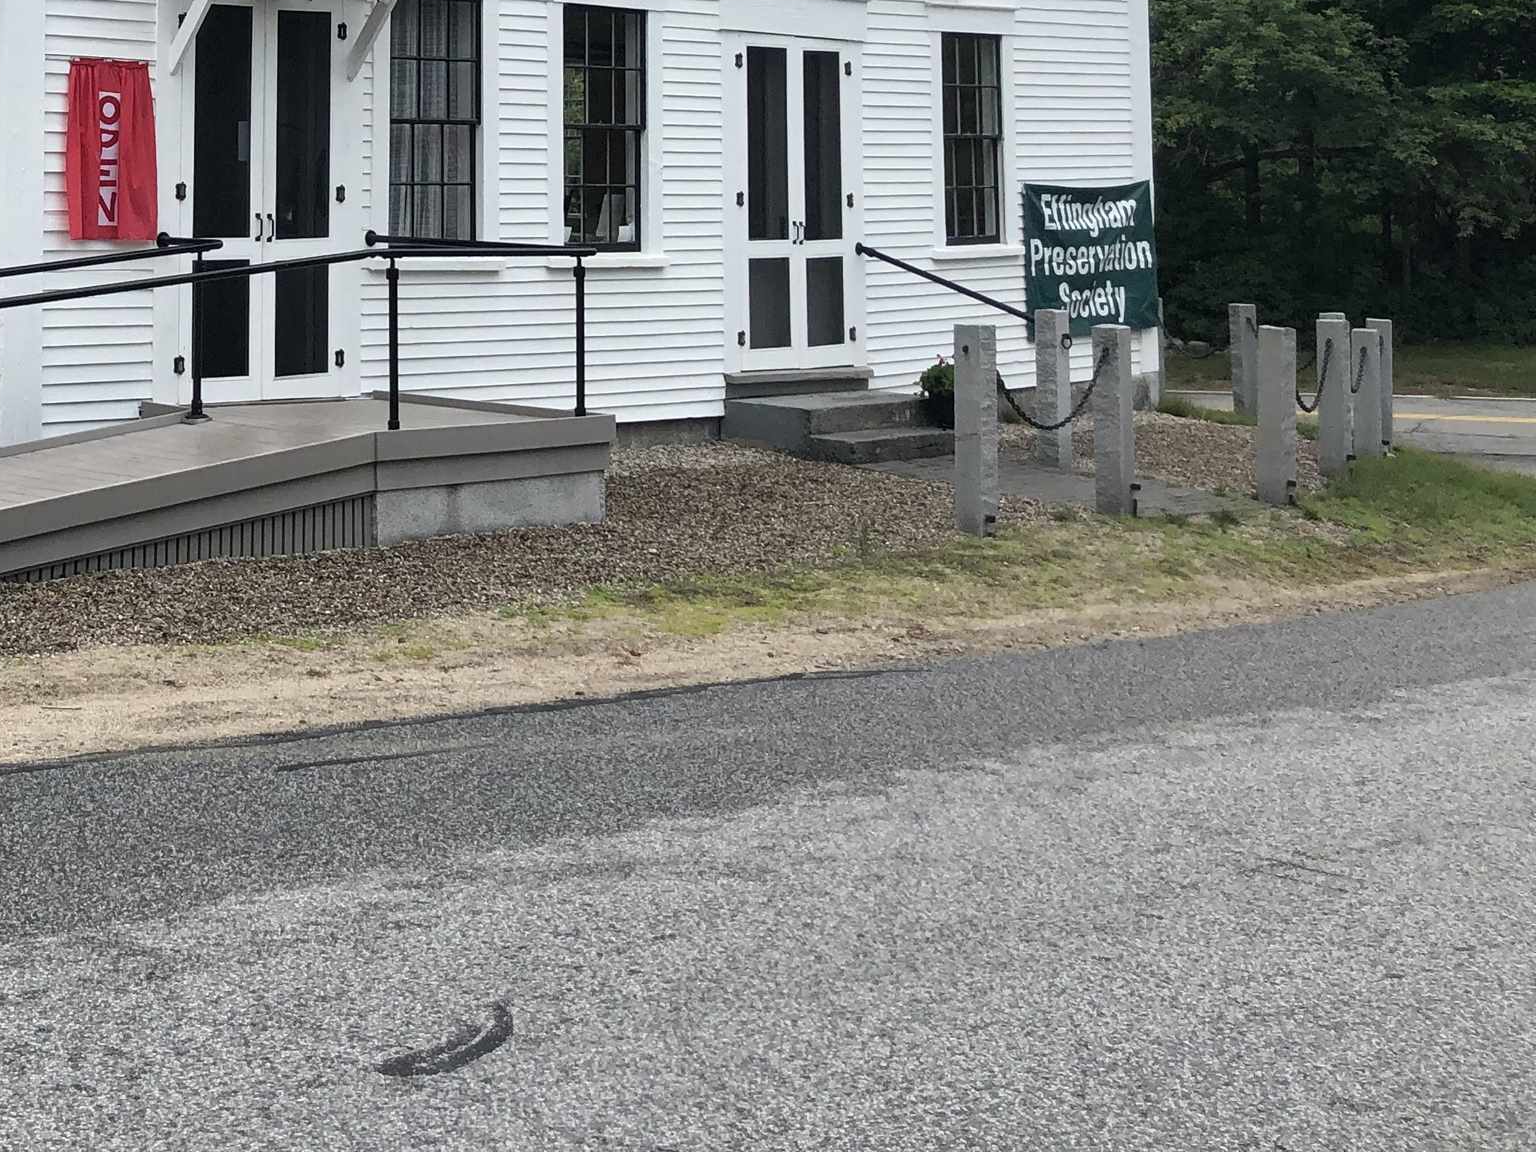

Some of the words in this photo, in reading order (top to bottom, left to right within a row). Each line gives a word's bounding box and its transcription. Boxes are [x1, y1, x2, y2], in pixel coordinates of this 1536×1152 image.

[99, 95, 121, 223] OPEN
[1041, 193, 1137, 238] Effingham
[1030, 234, 1153, 277] Preservation
[1059, 279, 1126, 323] Society
